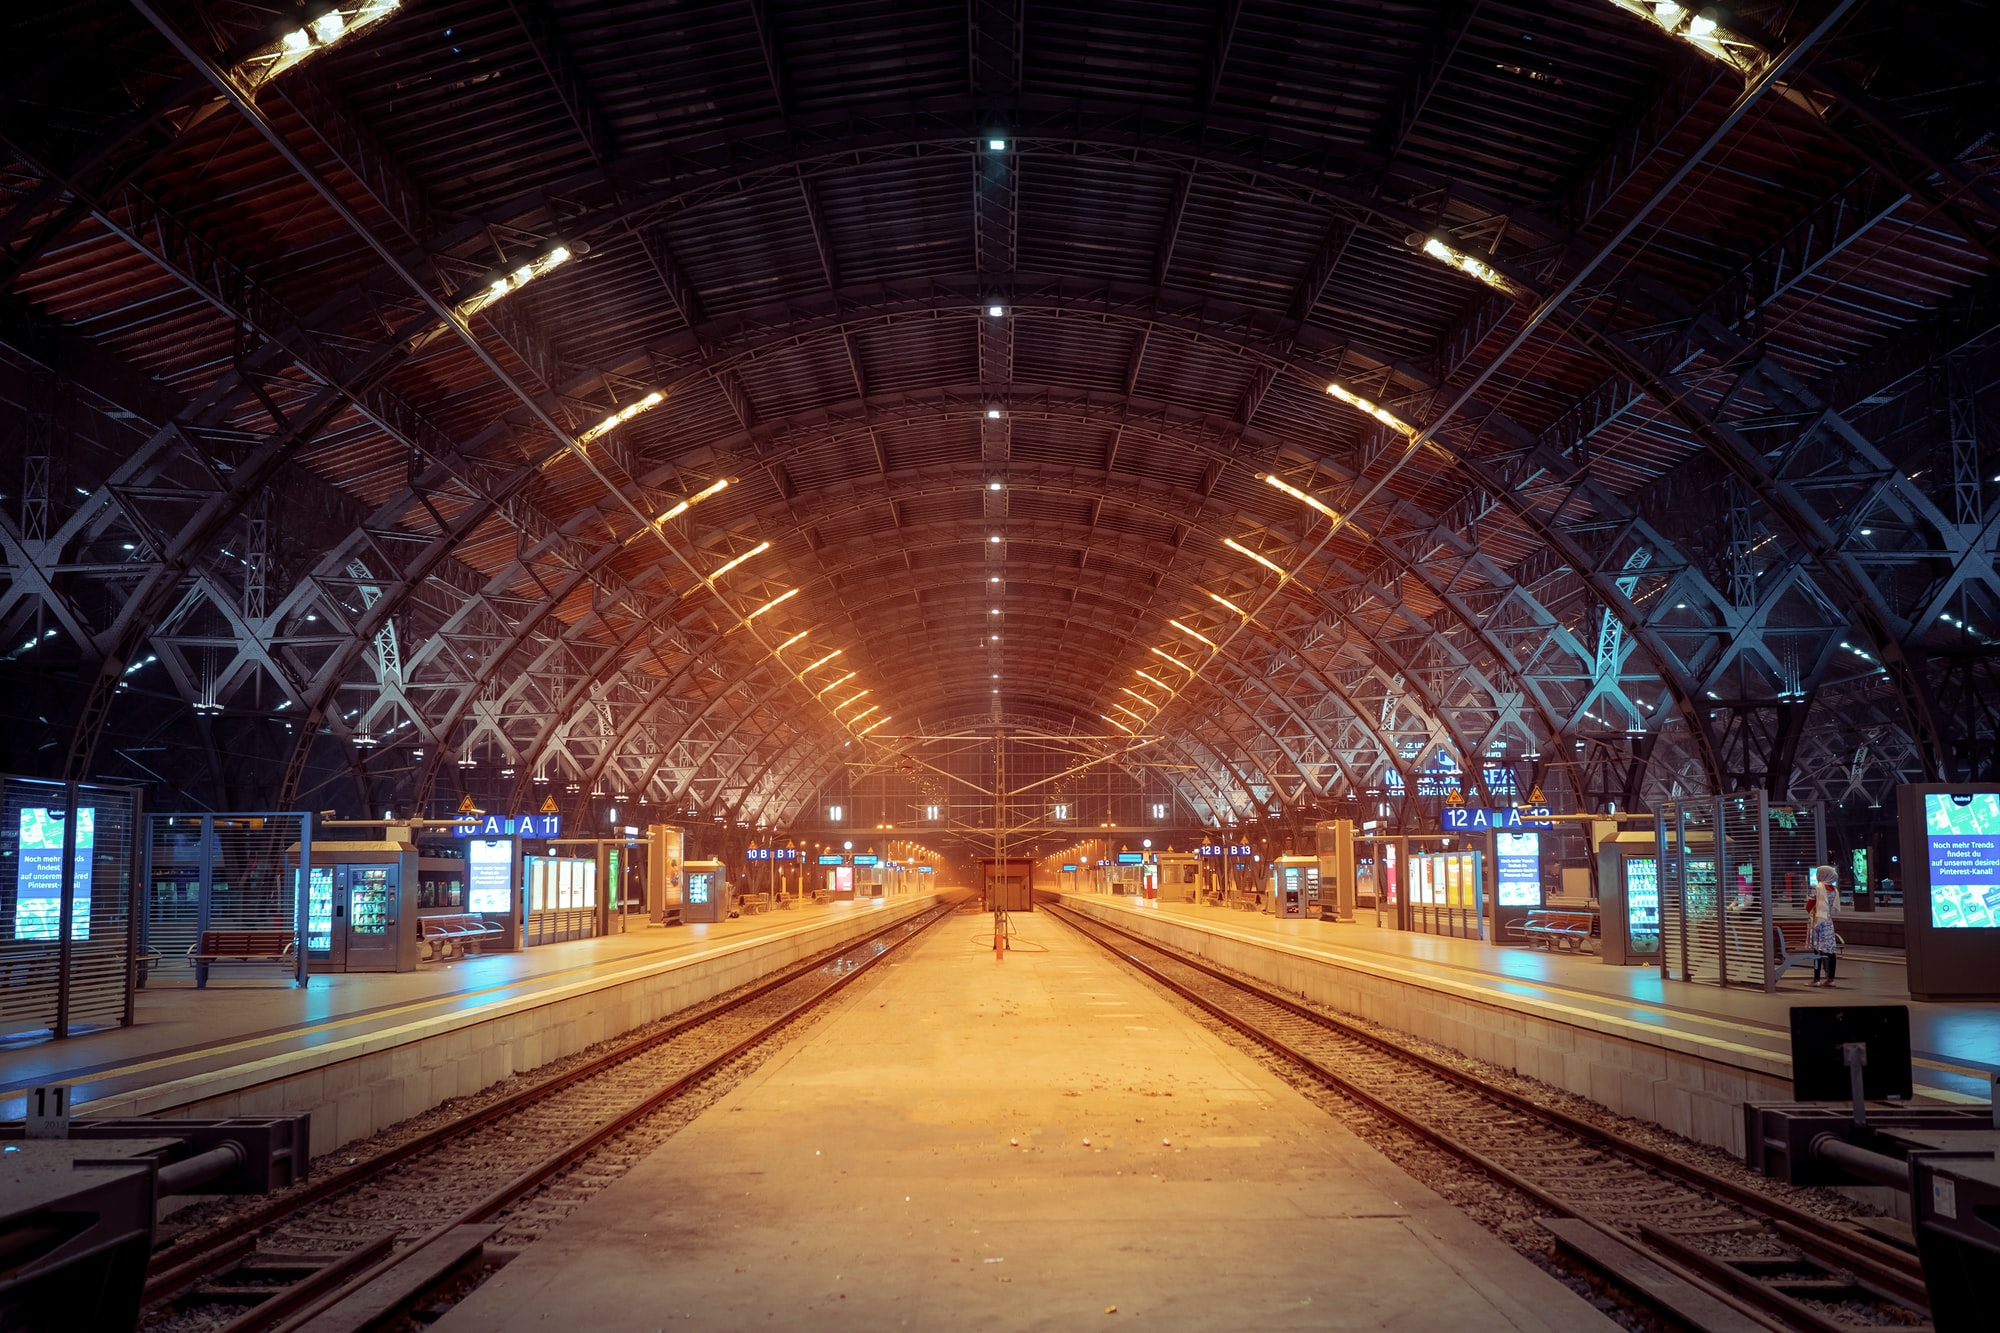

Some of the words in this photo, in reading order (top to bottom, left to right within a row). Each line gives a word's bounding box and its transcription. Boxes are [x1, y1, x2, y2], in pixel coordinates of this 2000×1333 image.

[927, 806, 939, 820] 11
[1055, 805, 1067, 819] 12
[1153, 804, 1164, 819] 13
[1447, 809, 1468, 826] 12
[1473, 809, 1487, 826] A
[1508, 809, 1522, 826] A
[1530, 808, 1550, 826] 13
[455, 816, 476, 834] 10
[484, 816, 499, 833] A
[519, 816, 534, 833] A
[542, 816, 558, 833] 11
[1231, 846, 1238, 854] B
[1241, 846, 1251, 854] 13
[1933, 841, 1951, 849] Noch
[1952, 841, 1970, 849] mehr
[1971, 841, 1994, 849] Trends
[747, 849, 758, 859] 10
[760, 849, 767, 858] B
[777, 849, 784, 858] B
[787, 849, 796, 858] 11
[1201, 846, 1211, 855] 12
[1214, 846, 1221, 854] B
[1947, 850, 1970, 858] findest
[1972, 850, 1981, 858] du
[24, 855, 41, 863] Noch
[43, 855, 60, 863] mehr
[1931, 859, 1943, 867] auf
[1944, 859, 1973, 867] unserem
[1975, 858, 2000, 867] desired
[20, 872, 32, 880] auf
[1940, 867, 1993, 875] Pinterest-Kanal!
[34, 1087, 64, 1117] 11
[44, 1120, 66, 1130] 2015
